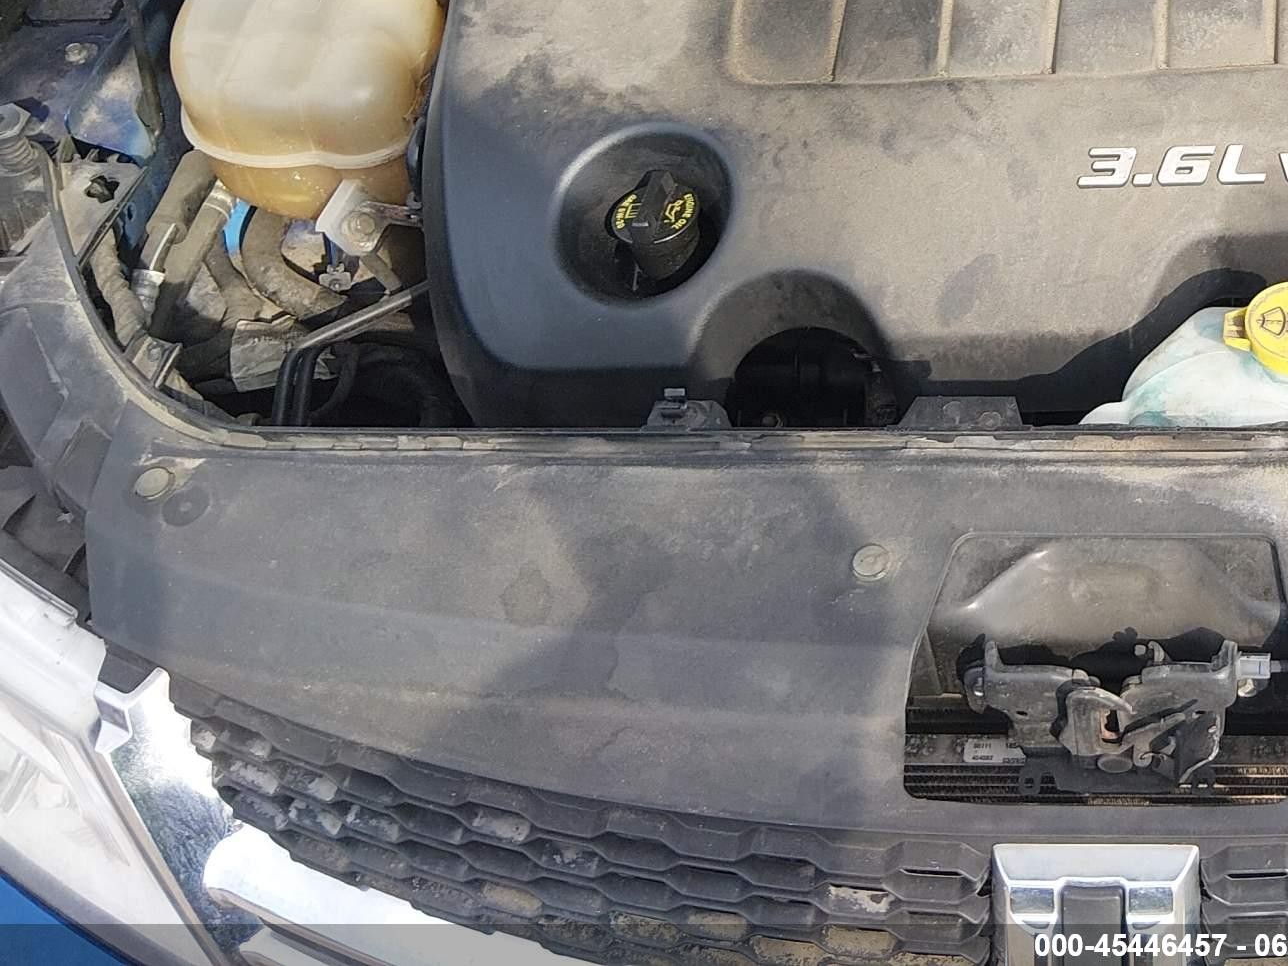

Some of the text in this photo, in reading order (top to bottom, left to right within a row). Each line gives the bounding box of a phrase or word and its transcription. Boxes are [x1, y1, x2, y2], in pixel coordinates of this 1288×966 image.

[1077, 144, 1267, 189] 3.6L
[670, 193, 695, 230] ENGINE OIL
